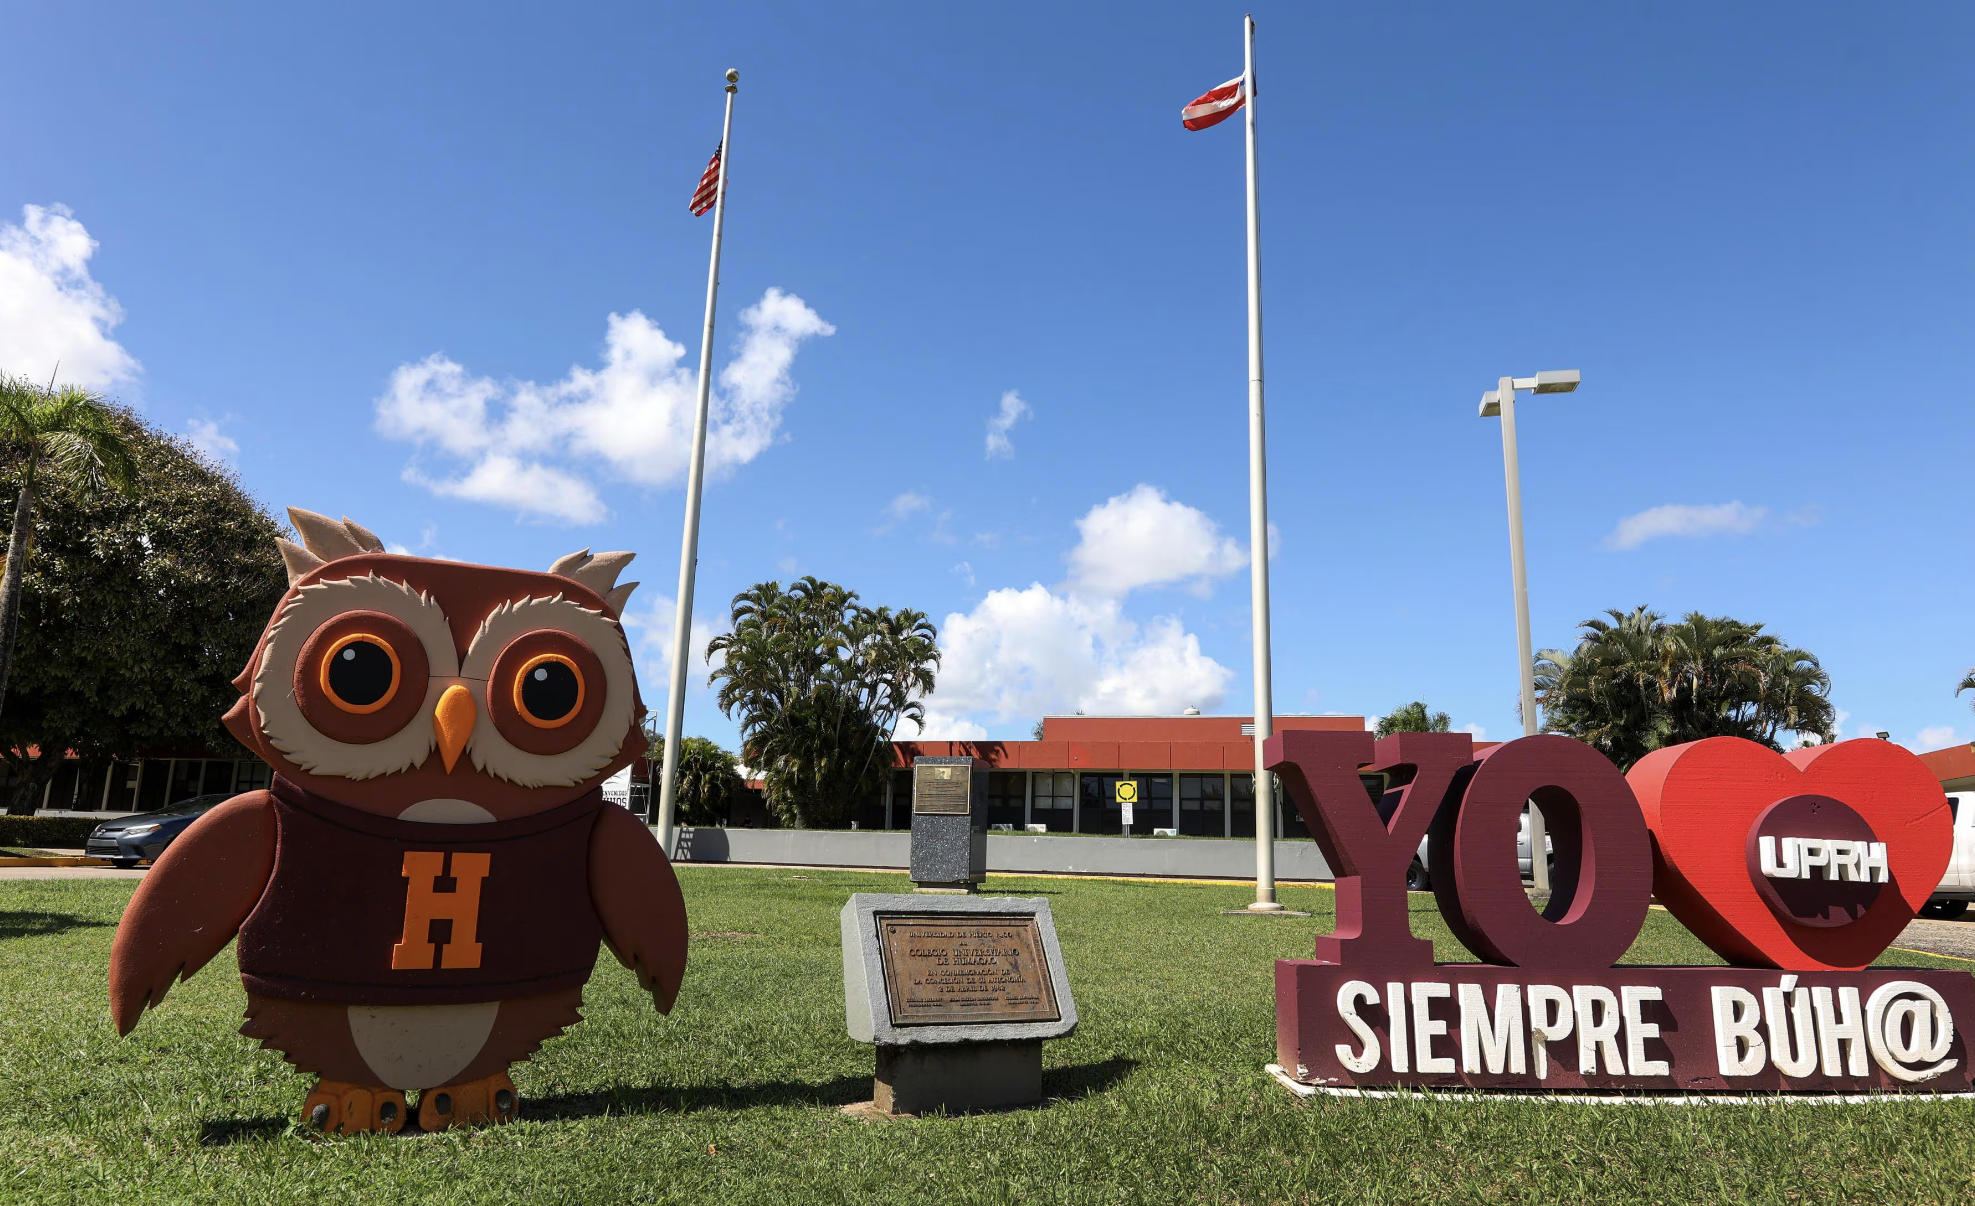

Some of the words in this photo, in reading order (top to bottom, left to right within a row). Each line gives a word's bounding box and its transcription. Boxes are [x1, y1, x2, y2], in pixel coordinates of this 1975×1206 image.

[1263, 730, 1653, 968] YO
[1759, 836, 1889, 883] UPRH
[392, 851, 491, 970] H
[909, 948, 948, 957] COLEGIO
[953, 948, 1020, 957] UNIVERSITARIO
[937, 957, 949, 965] DE
[953, 957, 997, 965] HUMACAO
[1334, 980, 1670, 1079] SIEMPRE
[1711, 974, 1959, 1083] BÚH@
